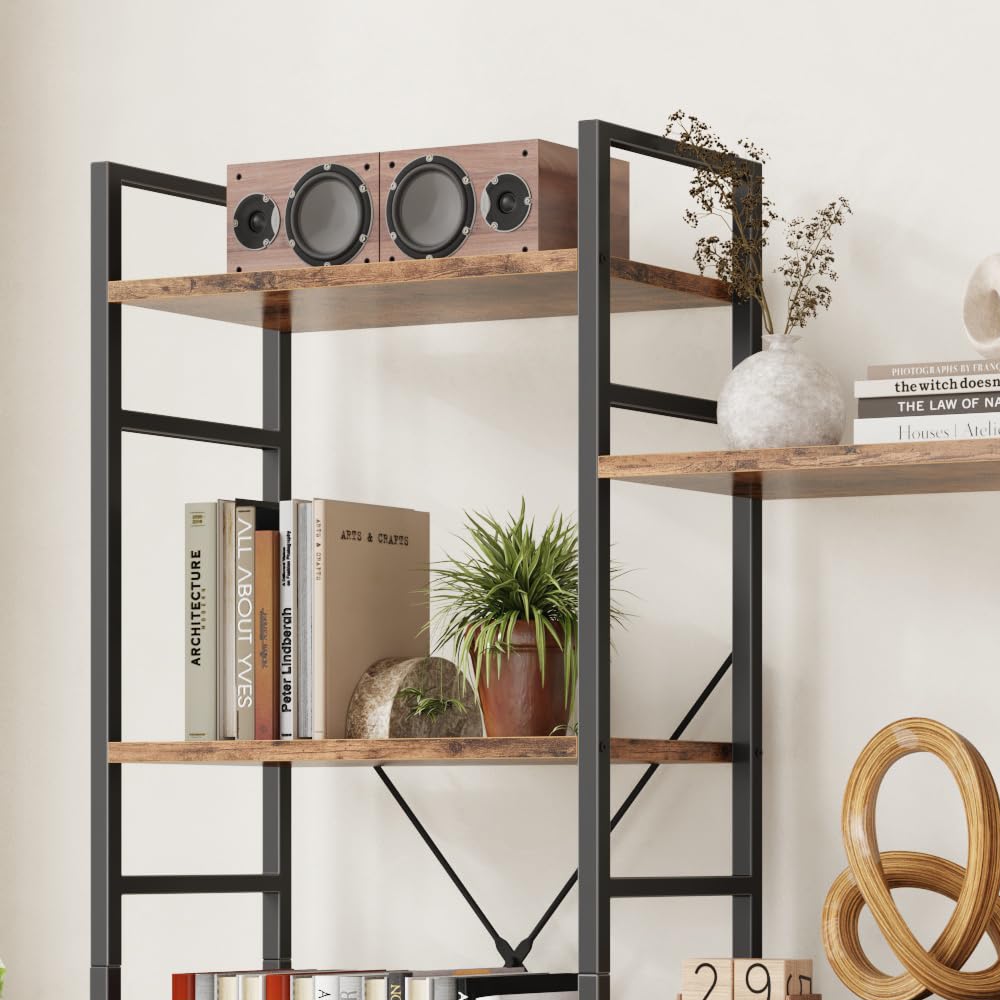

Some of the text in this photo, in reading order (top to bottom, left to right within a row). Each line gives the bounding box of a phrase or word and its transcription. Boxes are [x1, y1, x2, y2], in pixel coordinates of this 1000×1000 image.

[892, 365, 958, 376] PHOTOGRAPHS
[960, 364, 970, 373] BY
[895, 381, 917, 392] the
[919, 378, 957, 392] witch
[898, 401, 924, 412] THE
[930, 400, 957, 411] LAW
[962, 398, 979, 409] OF
[899, 425, 949, 441] Houses
[340, 530, 409, 547] ARTS & CRAFTS
[191, 549, 201, 666] ARCHITECTURE
[237, 518, 252, 708] ALL ABOUT YVES
[281, 607, 292, 712] Peter Lindbergh
